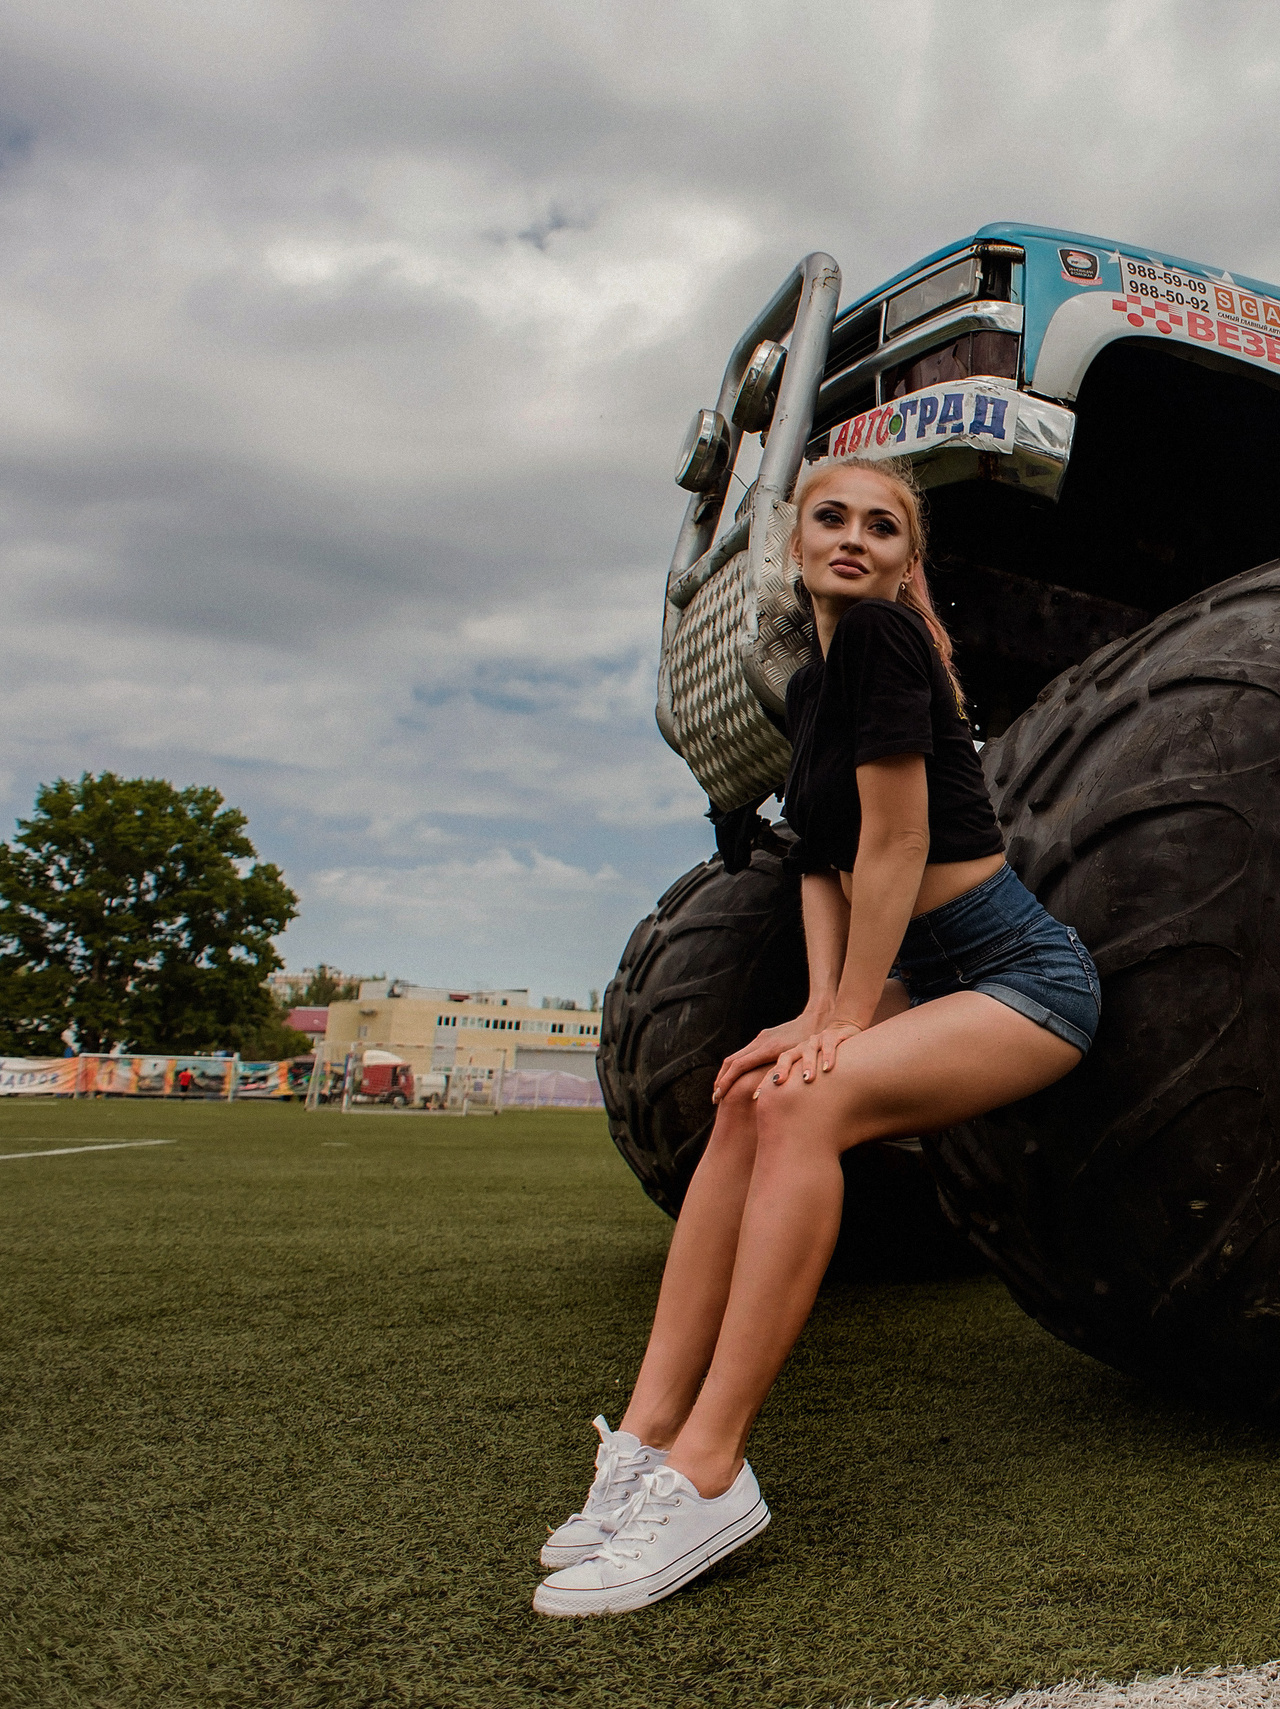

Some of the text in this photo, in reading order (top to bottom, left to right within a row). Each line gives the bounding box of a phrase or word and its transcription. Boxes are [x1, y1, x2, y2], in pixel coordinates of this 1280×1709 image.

[1127, 262, 1207, 295] 988-59-09
[1129, 280, 1210, 313] 988-50-92
[1217, 312, 1240, 322] САМЫЙ
[1240, 318, 1268, 332] ГЛАВНЫЙ
